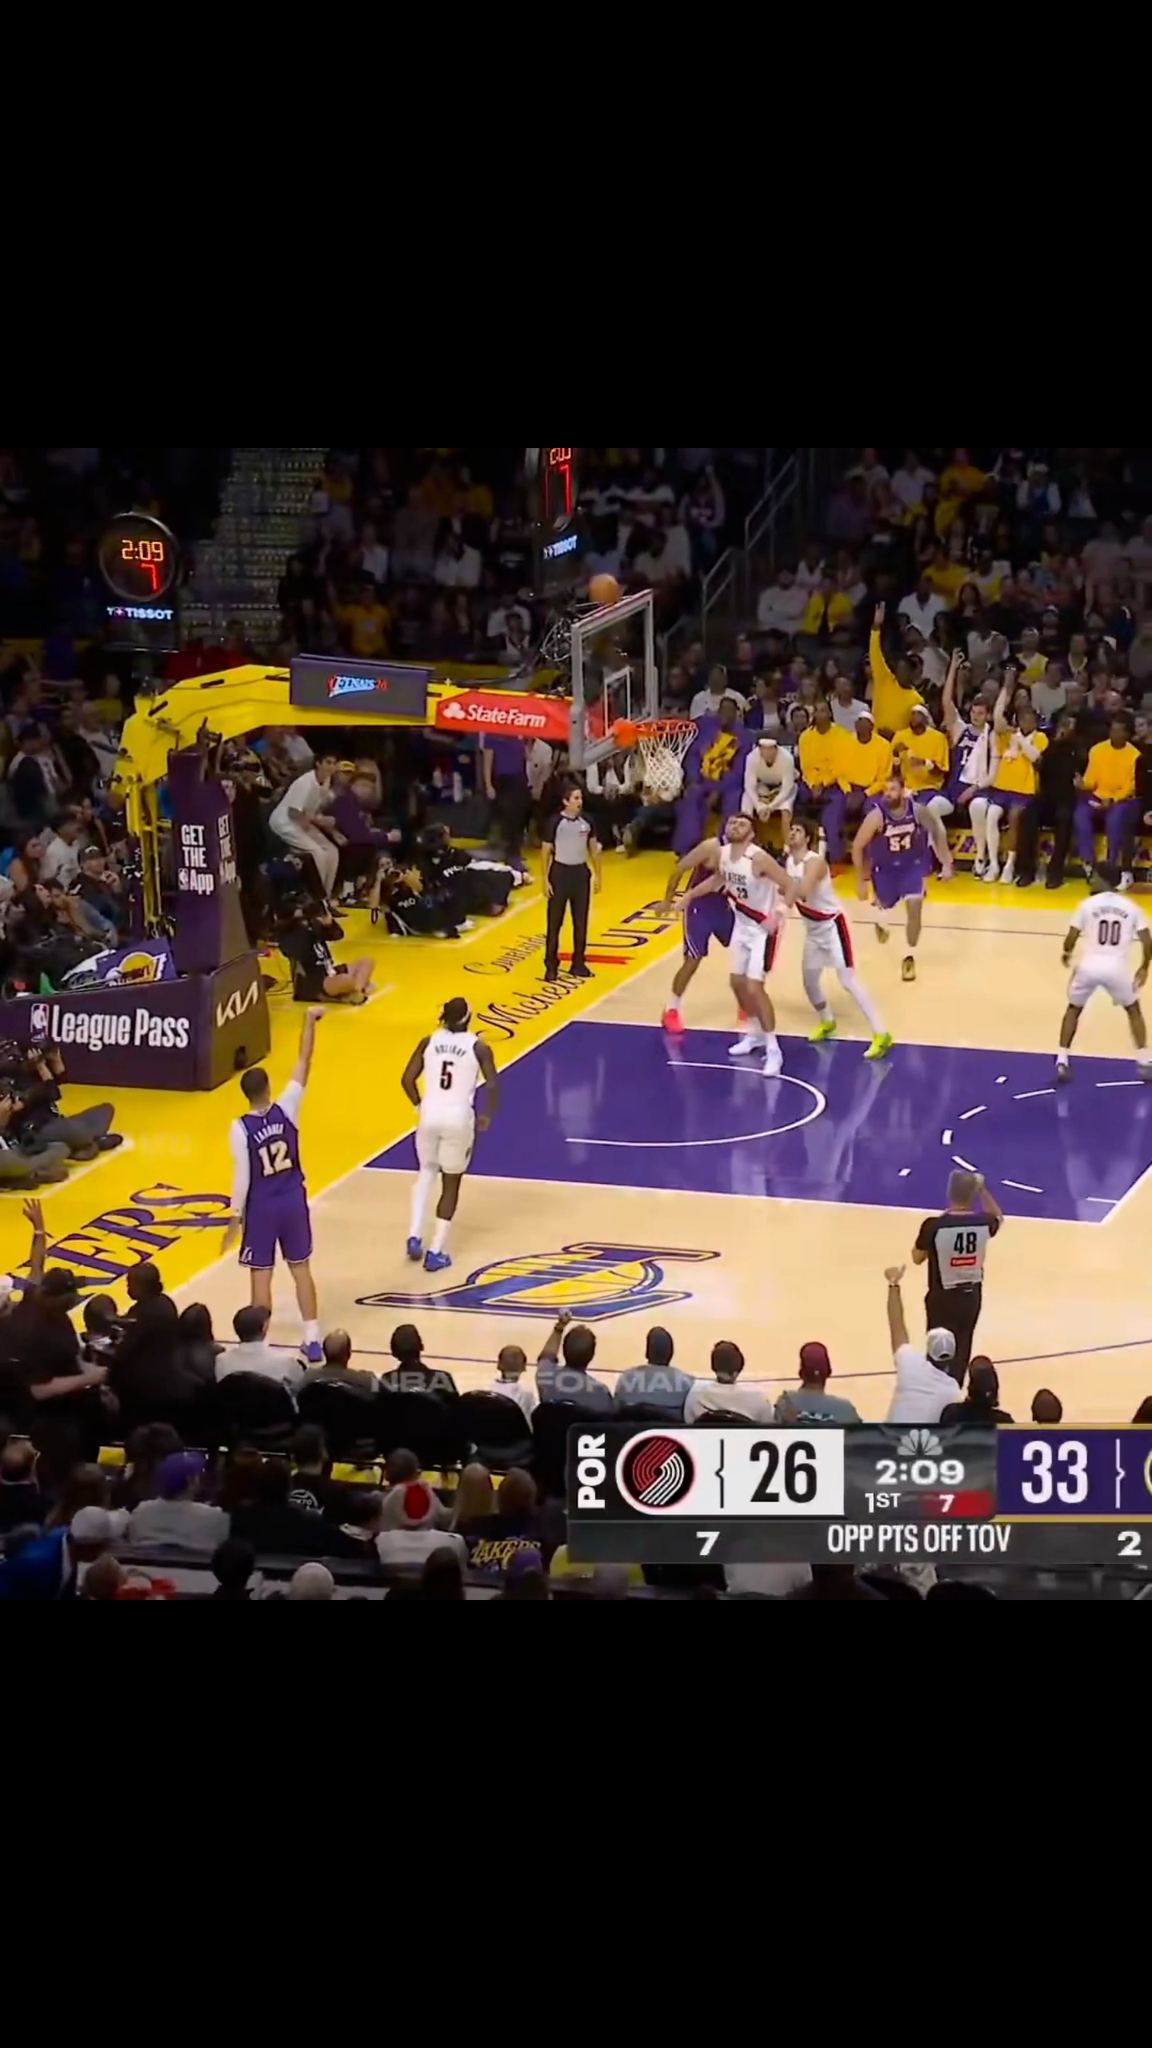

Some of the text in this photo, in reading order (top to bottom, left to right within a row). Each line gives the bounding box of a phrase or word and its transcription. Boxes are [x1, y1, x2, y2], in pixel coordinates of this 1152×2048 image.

[122, 540, 164, 561] 2:09
[141, 563, 157, 590] 7
[181, 824, 205, 846] GET
[889, 834, 911, 852] 54
[182, 846, 207, 868] THE
[190, 869, 214, 895] App
[1098, 920, 1121, 945] 00
[52, 1004, 190, 1051] League Pass
[440, 1060, 454, 1091] 5
[259, 1140, 293, 1177] 12
[954, 1231, 977, 1255] 48
